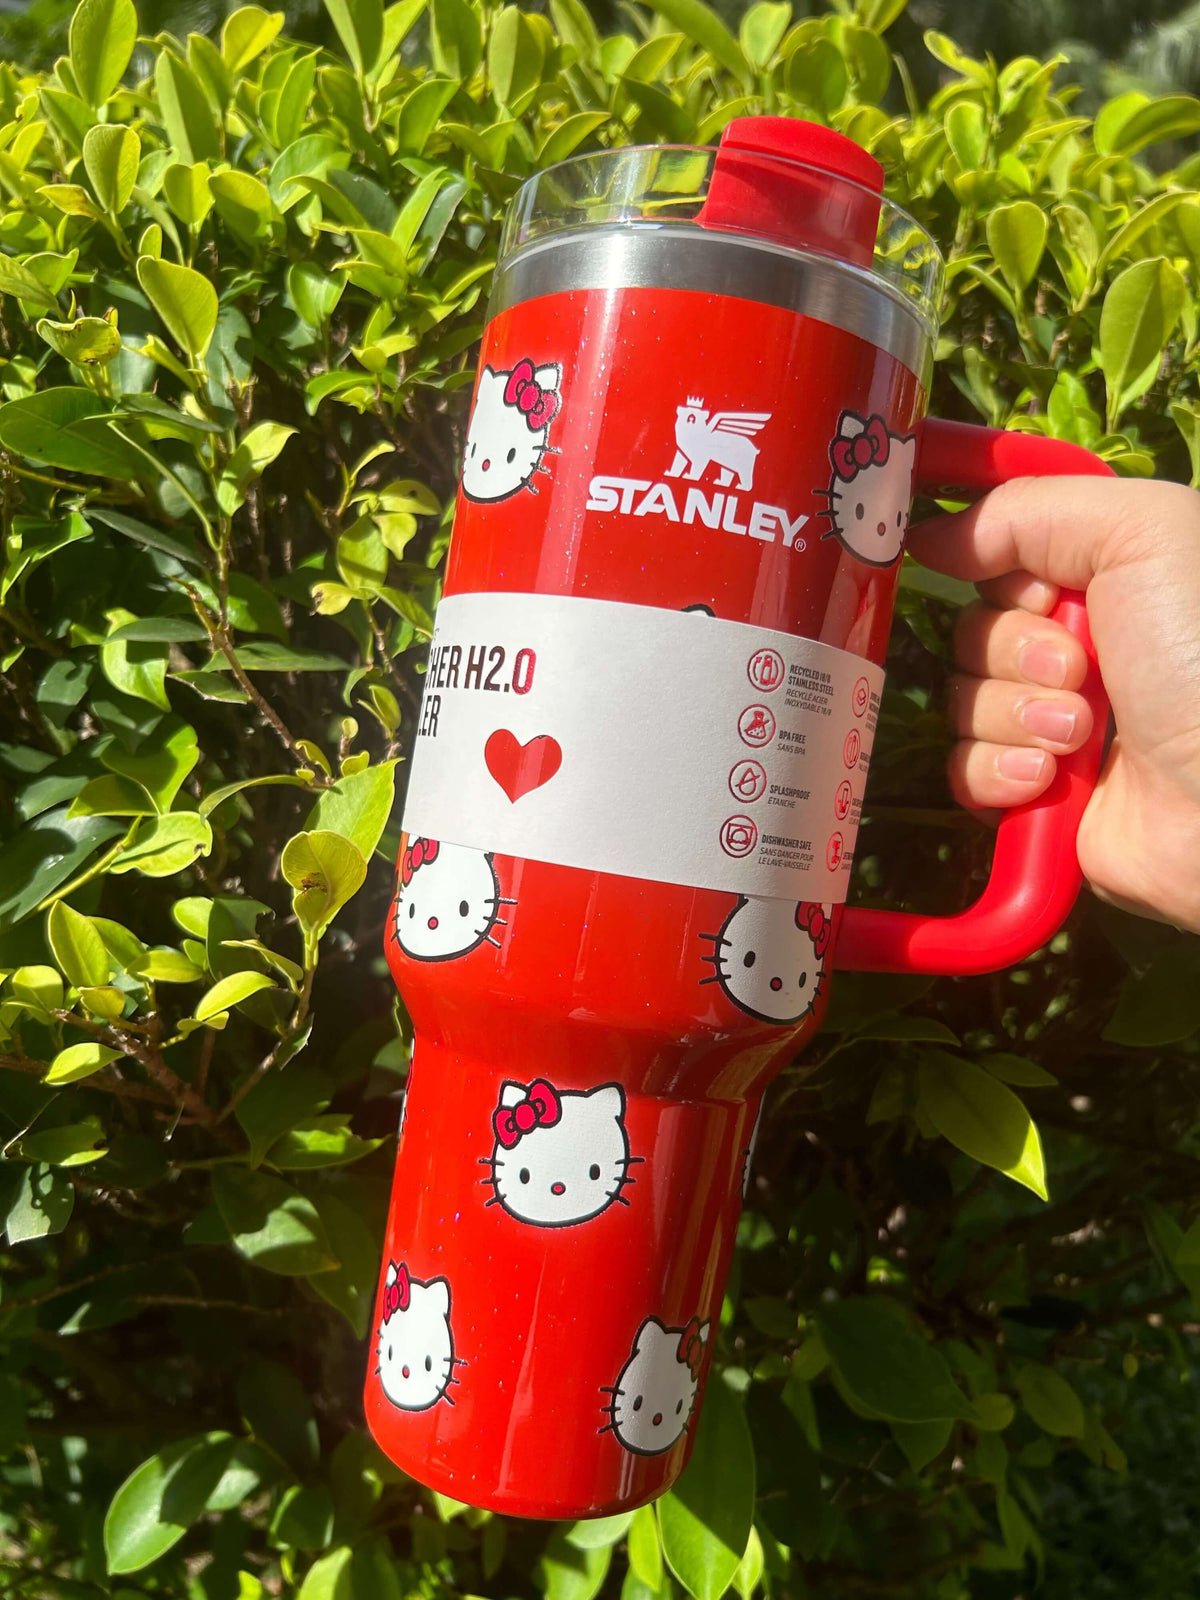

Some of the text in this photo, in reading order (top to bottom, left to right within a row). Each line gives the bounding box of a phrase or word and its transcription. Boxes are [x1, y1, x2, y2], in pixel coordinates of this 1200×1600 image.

[585, 475, 809, 547] STANLEY
[464, 645, 537, 695] H2.0
[790, 664, 819, 680] RECYCLED
[788, 676, 834, 696] STAINLESS STEEL
[784, 698, 821, 713] INOXYDABLE
[812, 695, 829, 706] ACIER
[418, 694, 442, 737] ER
[779, 730, 806, 744] BPA FREE
[777, 743, 806, 755] SANS BPA
[769, 784, 811, 800] SPLASHPROOF
[761, 834, 812, 851] DISHWASHER SAFE
[760, 846, 814, 862] SANS DANGER POUR
[758, 856, 811, 871] LE LAVE-VAISSELLE
